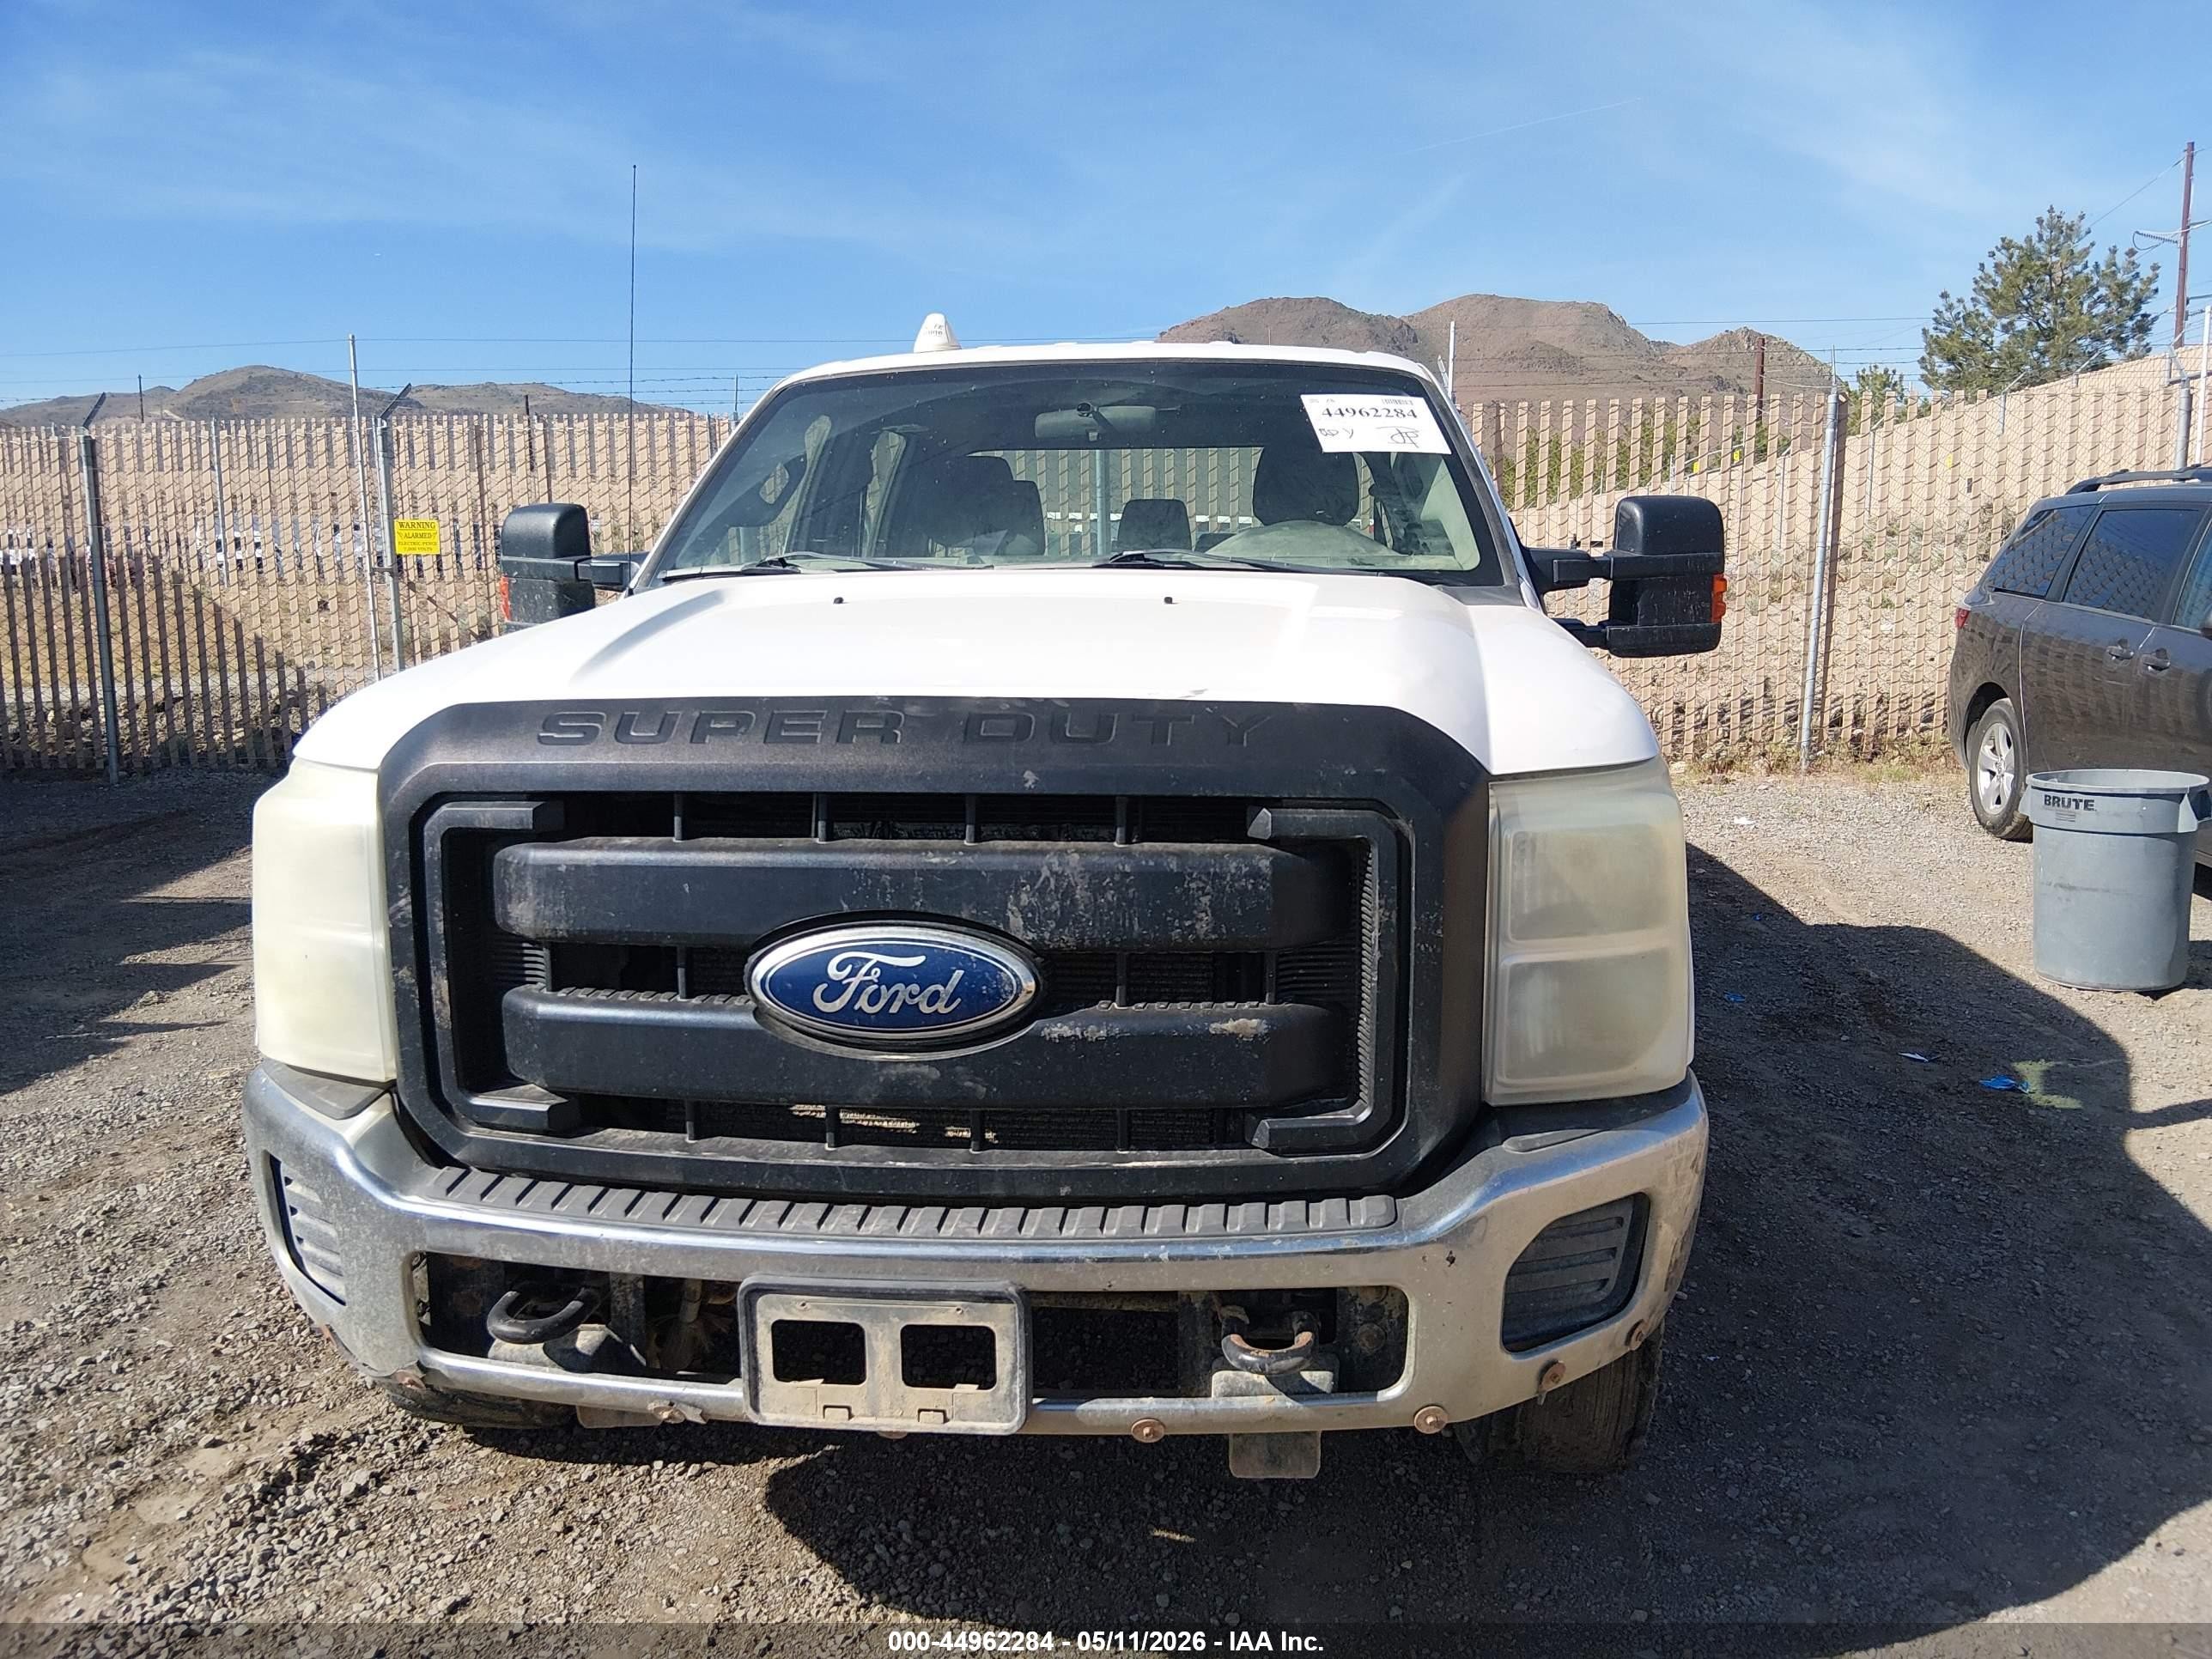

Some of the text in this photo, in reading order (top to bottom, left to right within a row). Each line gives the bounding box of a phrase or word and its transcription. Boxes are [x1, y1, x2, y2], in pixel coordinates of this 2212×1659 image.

[1322, 407, 1418, 419] 44962284
[537, 710, 1274, 747] SUPER DUTY
[2044, 794, 2096, 811] BRUTE
[812, 951, 965, 1014] Ford
